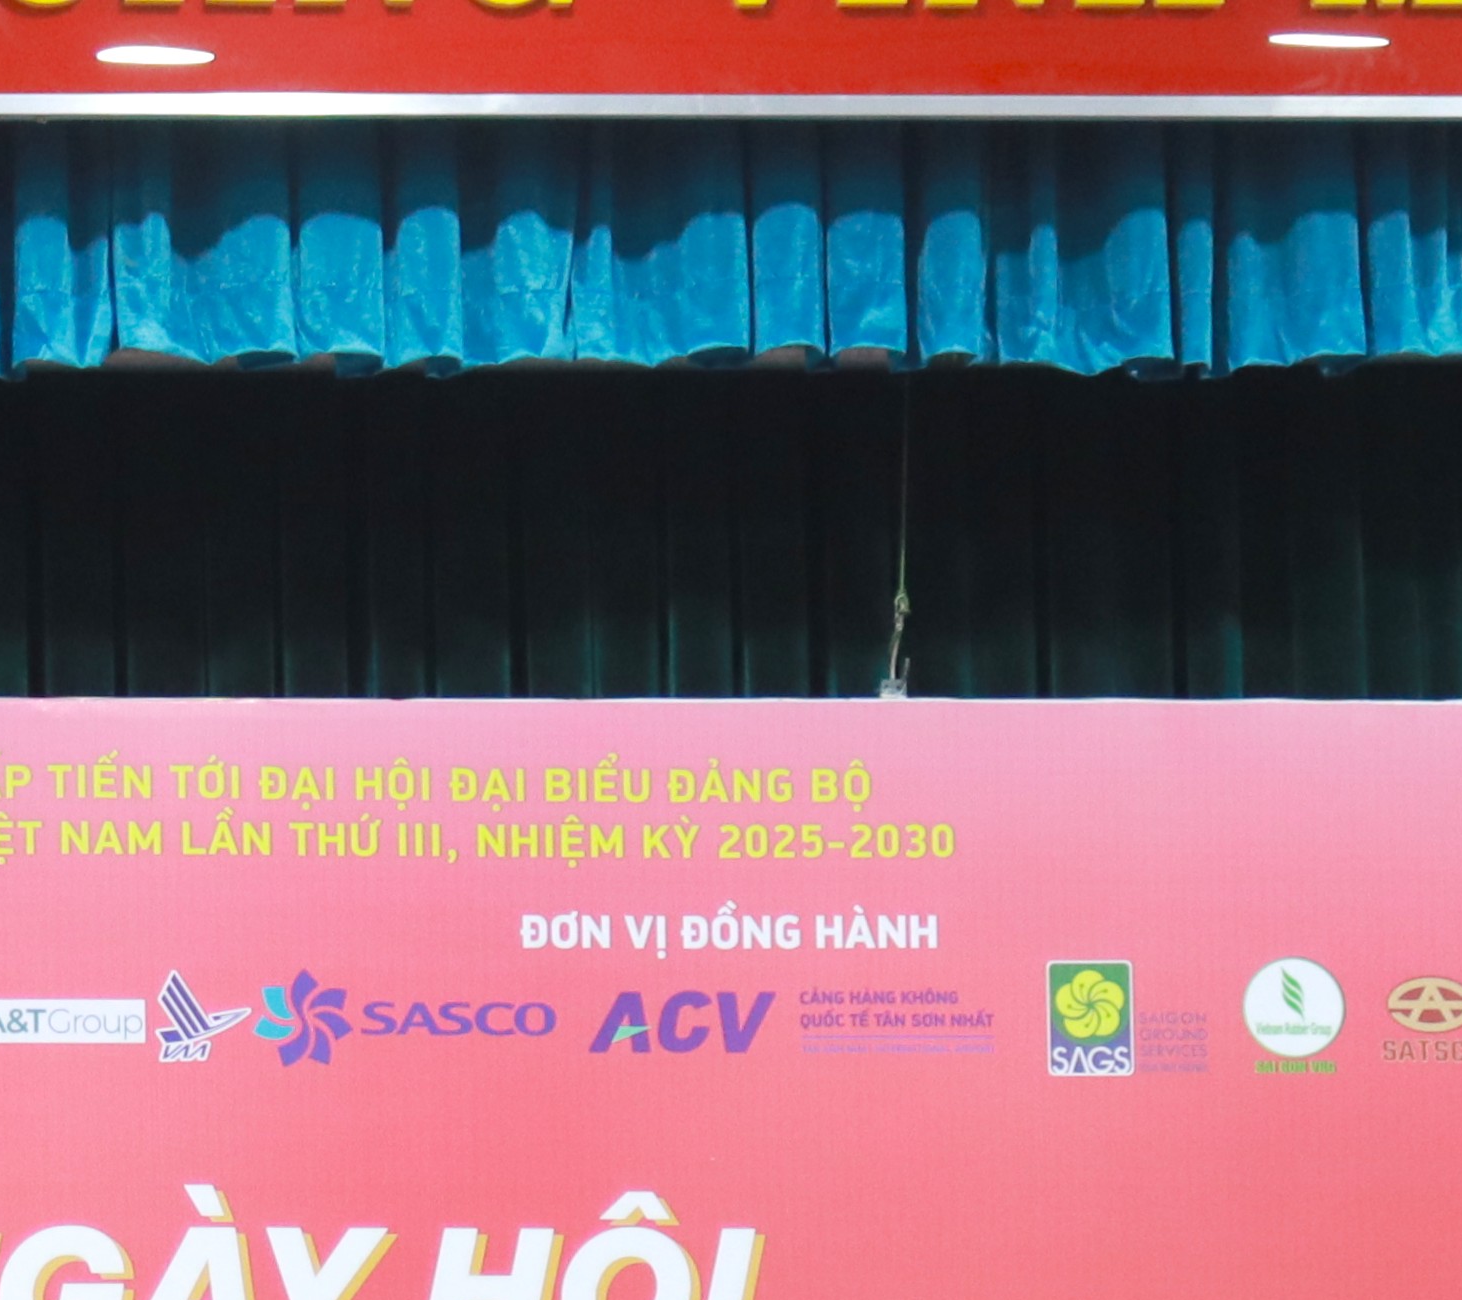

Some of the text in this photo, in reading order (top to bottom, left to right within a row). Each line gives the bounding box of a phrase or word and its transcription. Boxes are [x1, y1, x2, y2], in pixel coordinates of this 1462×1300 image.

[47, 751, 152, 799] TIẾN
[170, 756, 240, 799] TỚI
[259, 766, 335, 809] ĐẠI
[355, 758, 431, 809] HỘI
[449, 767, 525, 809] ĐẠI
[544, 754, 651, 803] BIỂU
[667, 759, 793, 803] ĐẢNG
[811, 760, 871, 812] BỘ
[60, 821, 163, 854] NAM
[181, 808, 272, 855] LẦN
[289, 814, 381, 857] THỨ
[398, 821, 458, 862] III,
[477, 816, 625, 867] NHIỆM
[643, 816, 699, 858] KỲ
[718, 824, 955, 859] 2025-2030
[521, 901, 937, 958] ĐƠN VỊ ĐỒNG HÀNH
[360, 1001, 557, 1037] SASCO
[589, 991, 776, 1054] ACV
[1051, 1046, 1131, 1075] SAGS
